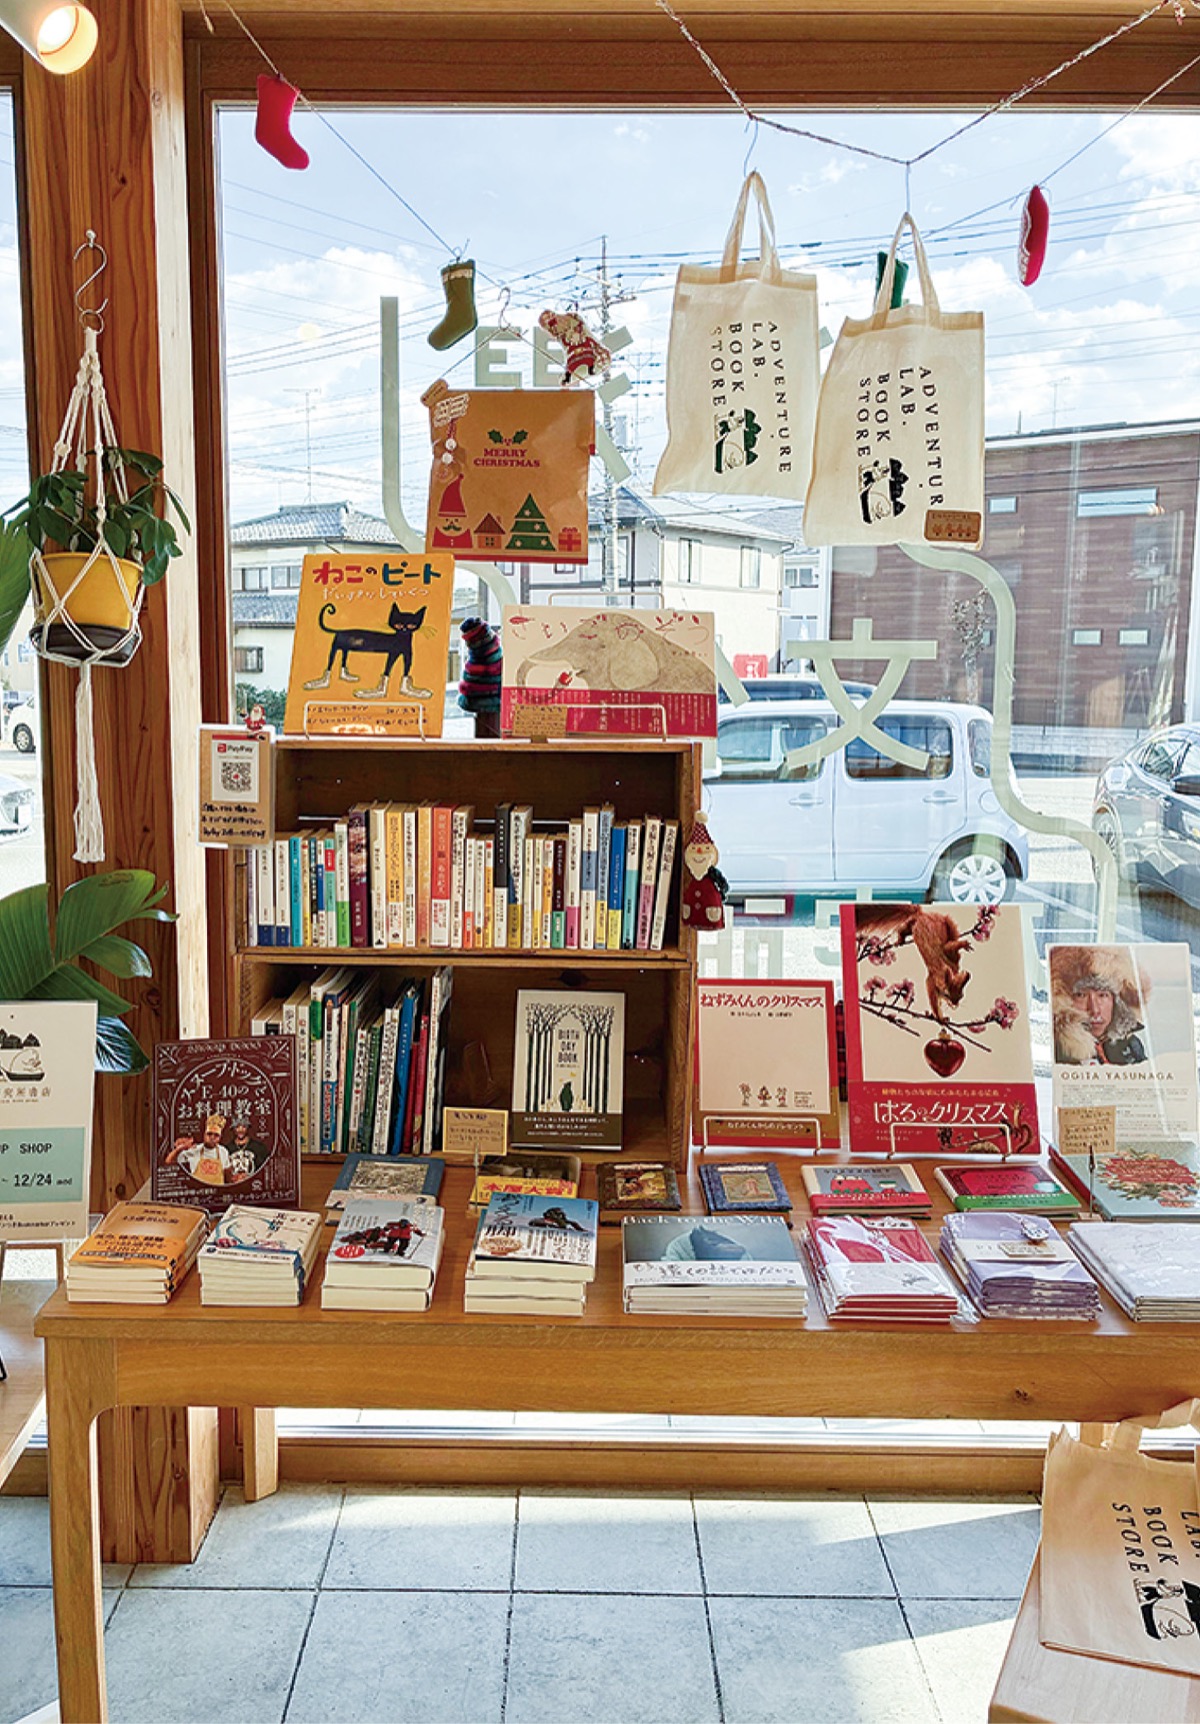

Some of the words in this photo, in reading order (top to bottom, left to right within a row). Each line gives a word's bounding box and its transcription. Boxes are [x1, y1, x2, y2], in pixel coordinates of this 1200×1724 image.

[728, 322, 745, 392] BOOK
[751, 322, 767, 378] LAB.
[710, 327, 727, 406] STORE
[768, 321, 792, 473] ADVENTURE
[874, 372, 891, 442] BOOK
[898, 367, 917, 426] LAB.
[855, 377, 872, 457] STORE
[918, 365, 944, 506] ADVENTUR
[473, 458, 540, 468] CHRISTMAS
[483, 448, 528, 458] MERRY
[312, 561, 441, 585] ねこのピート
[700, 992, 825, 1009] ねずみくんのクリスマス
[558, 1029, 580, 1041] BIRTH
[560, 1041, 577, 1051] DAY
[558, 1052, 579, 1063] BOOK
[1060, 1071, 1100, 1081] OGITA
[1105, 1071, 1174, 1080] YASUNAGA
[177, 1098, 272, 1119] お料理教室
[873, 1099, 1009, 1125] はるのクリスマス
[0, 1143, 9, 1154] P
[19, 1143, 52, 1154] SHOP
[14, 1172, 52, 1187] 12/24
[1111, 1502, 1150, 1574] STORE
[1142, 1506, 1179, 1567] BOOK
